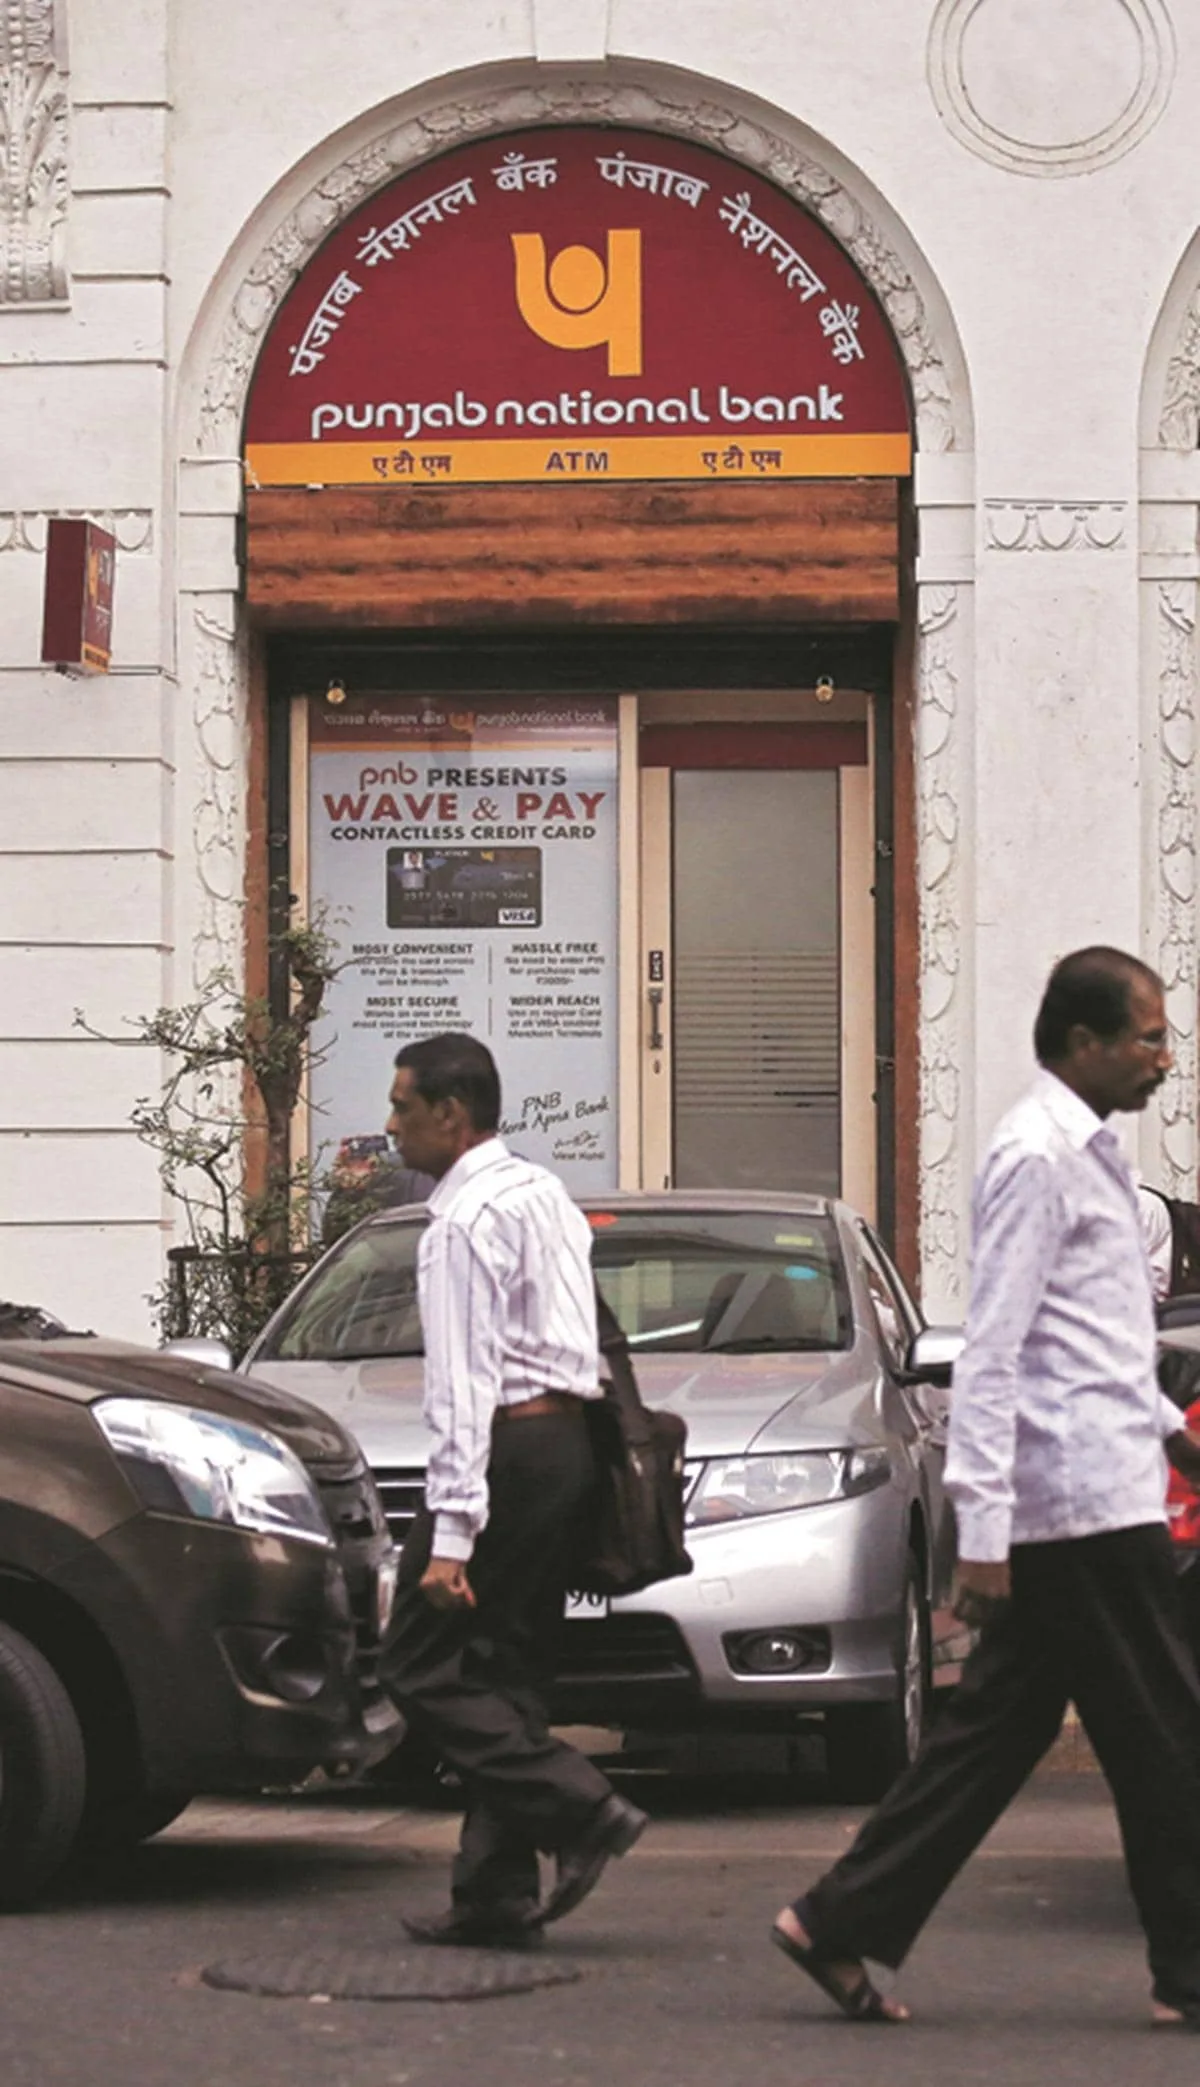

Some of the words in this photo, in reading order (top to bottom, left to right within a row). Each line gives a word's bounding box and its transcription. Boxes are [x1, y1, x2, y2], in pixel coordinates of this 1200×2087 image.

[288, 270, 363, 376] पंजाब
[491, 151, 558, 192] बँक
[596, 151, 710, 208] पंजाब
[718, 192, 827, 302] नैशनल
[819, 299, 865, 365] बैंक
[311, 390, 488, 440] punjab
[495, 387, 711, 427] national
[719, 384, 844, 422] bank
[372, 456, 388, 478] ए
[393, 450, 415, 475] टी
[421, 455, 452, 477] एम
[546, 451, 609, 472] ATM
[702, 450, 718, 473] ए
[722, 445, 744, 470] टी
[750, 449, 782, 472] एम
[360, 760, 418, 792] pnb
[427, 767, 567, 787] PRESENTS
[322, 792, 459, 822] WAVE
[472, 796, 501, 821] &
[516, 791, 606, 820] PAY
[331, 825, 466, 841] CONTACTLESS
[470, 825, 537, 840] CREDIT
[542, 825, 597, 840] CARD
[502, 911, 535, 921] VISA
[393, 943, 474, 955] CONVENIENT
[511, 942, 562, 954] HASSLE
[565, 942, 598, 954] FREE
[509, 996, 553, 1006] WIDER
[556, 996, 600, 1006] REACH
[521, 1091, 562, 1119] PNB
[575, 1095, 609, 1119] Bank
